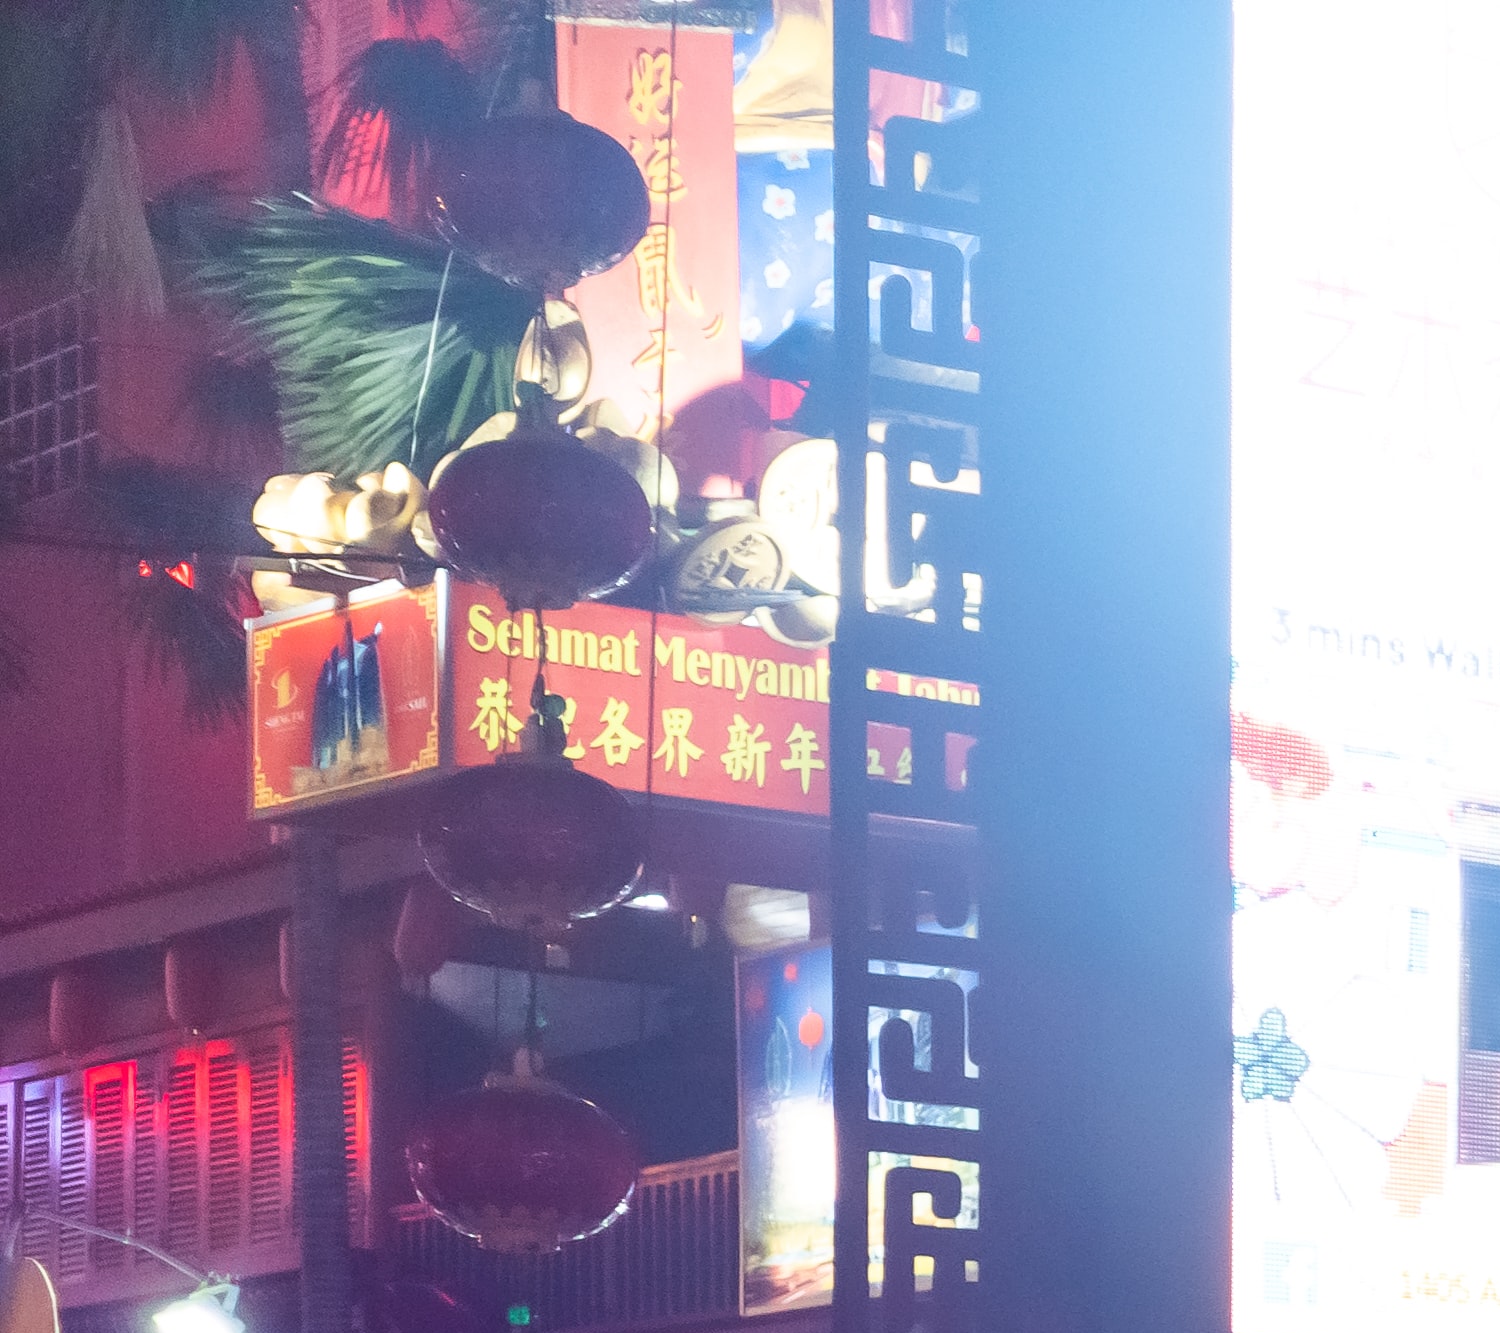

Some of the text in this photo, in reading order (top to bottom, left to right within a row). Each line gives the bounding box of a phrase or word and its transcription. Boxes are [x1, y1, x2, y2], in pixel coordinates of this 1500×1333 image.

[466, 603, 642, 678] Selamat
[1270, 605, 1293, 647] 3
[1307, 622, 1406, 667] mins
